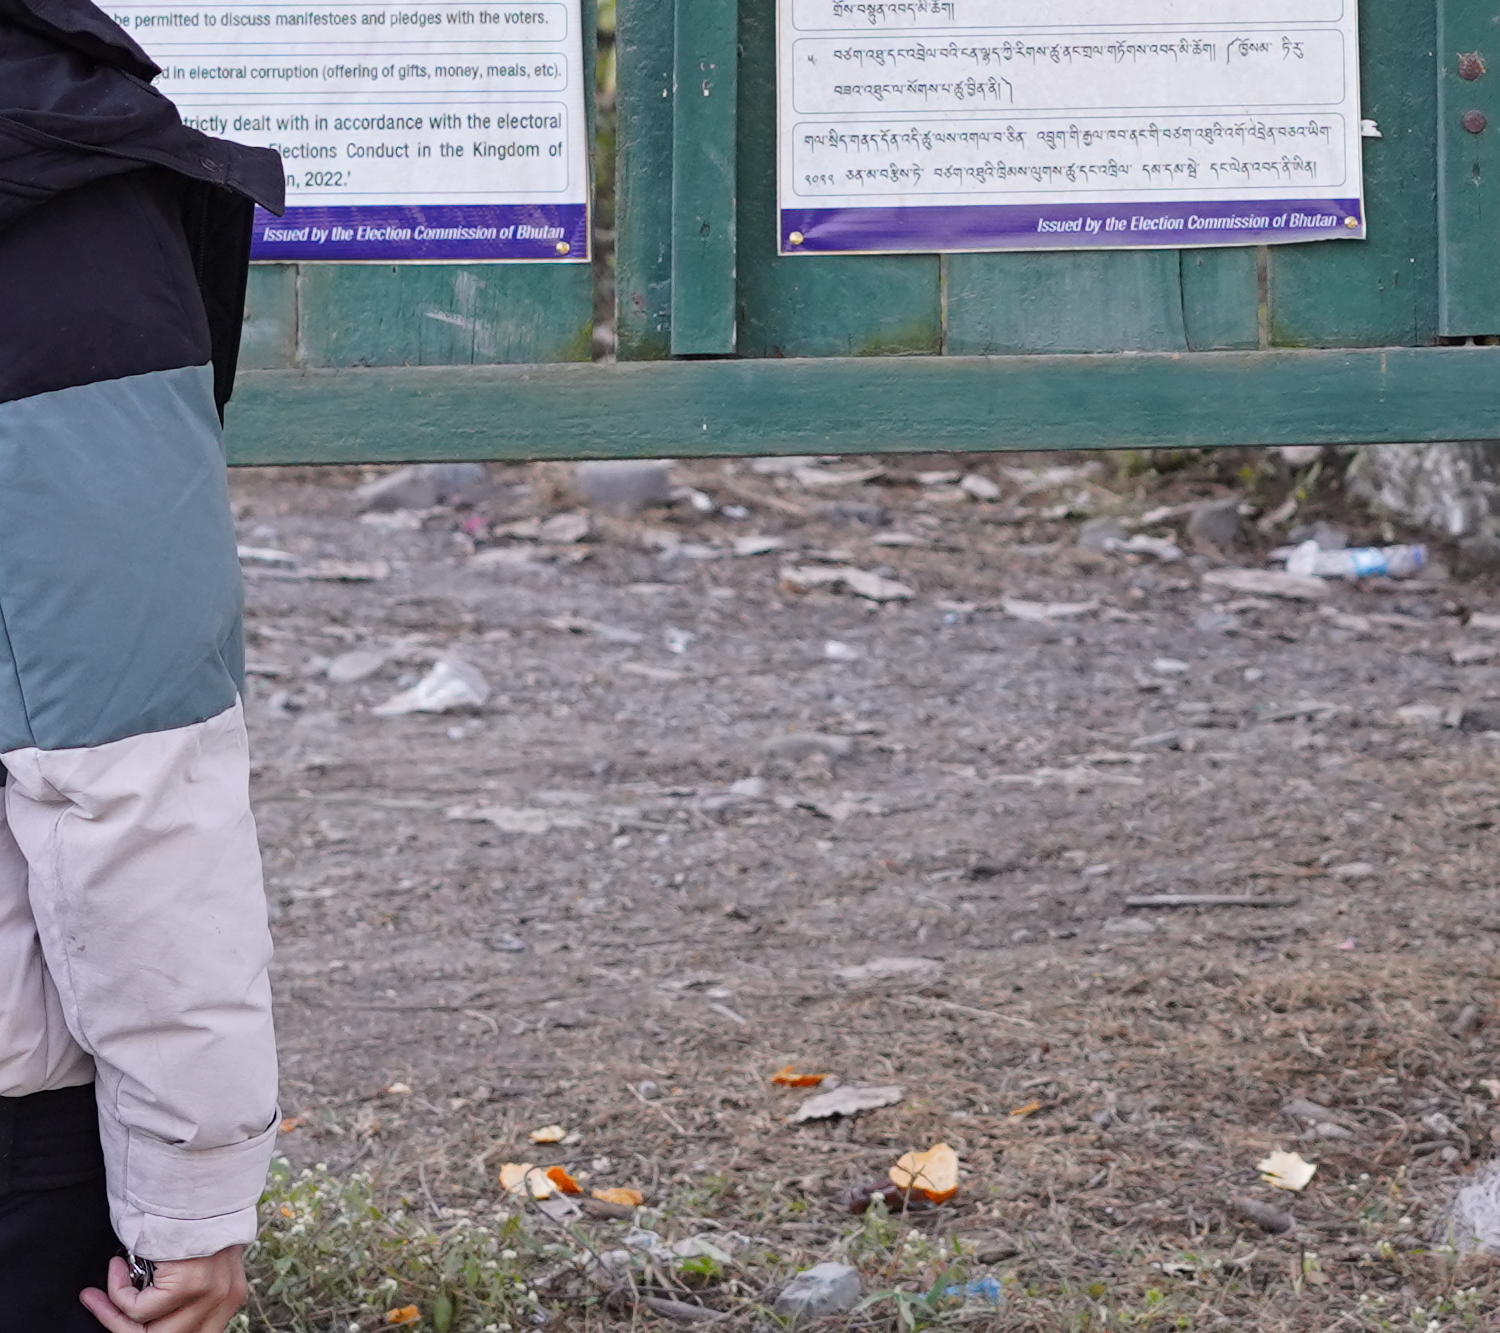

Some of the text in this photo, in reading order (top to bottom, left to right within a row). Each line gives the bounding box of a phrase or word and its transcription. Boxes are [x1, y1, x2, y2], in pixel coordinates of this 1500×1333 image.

[263, 224, 565, 244] Issued by the Election Commission of Bhutan
[1037, 213, 1337, 235] Issued by the Election Commission of Bhutan
